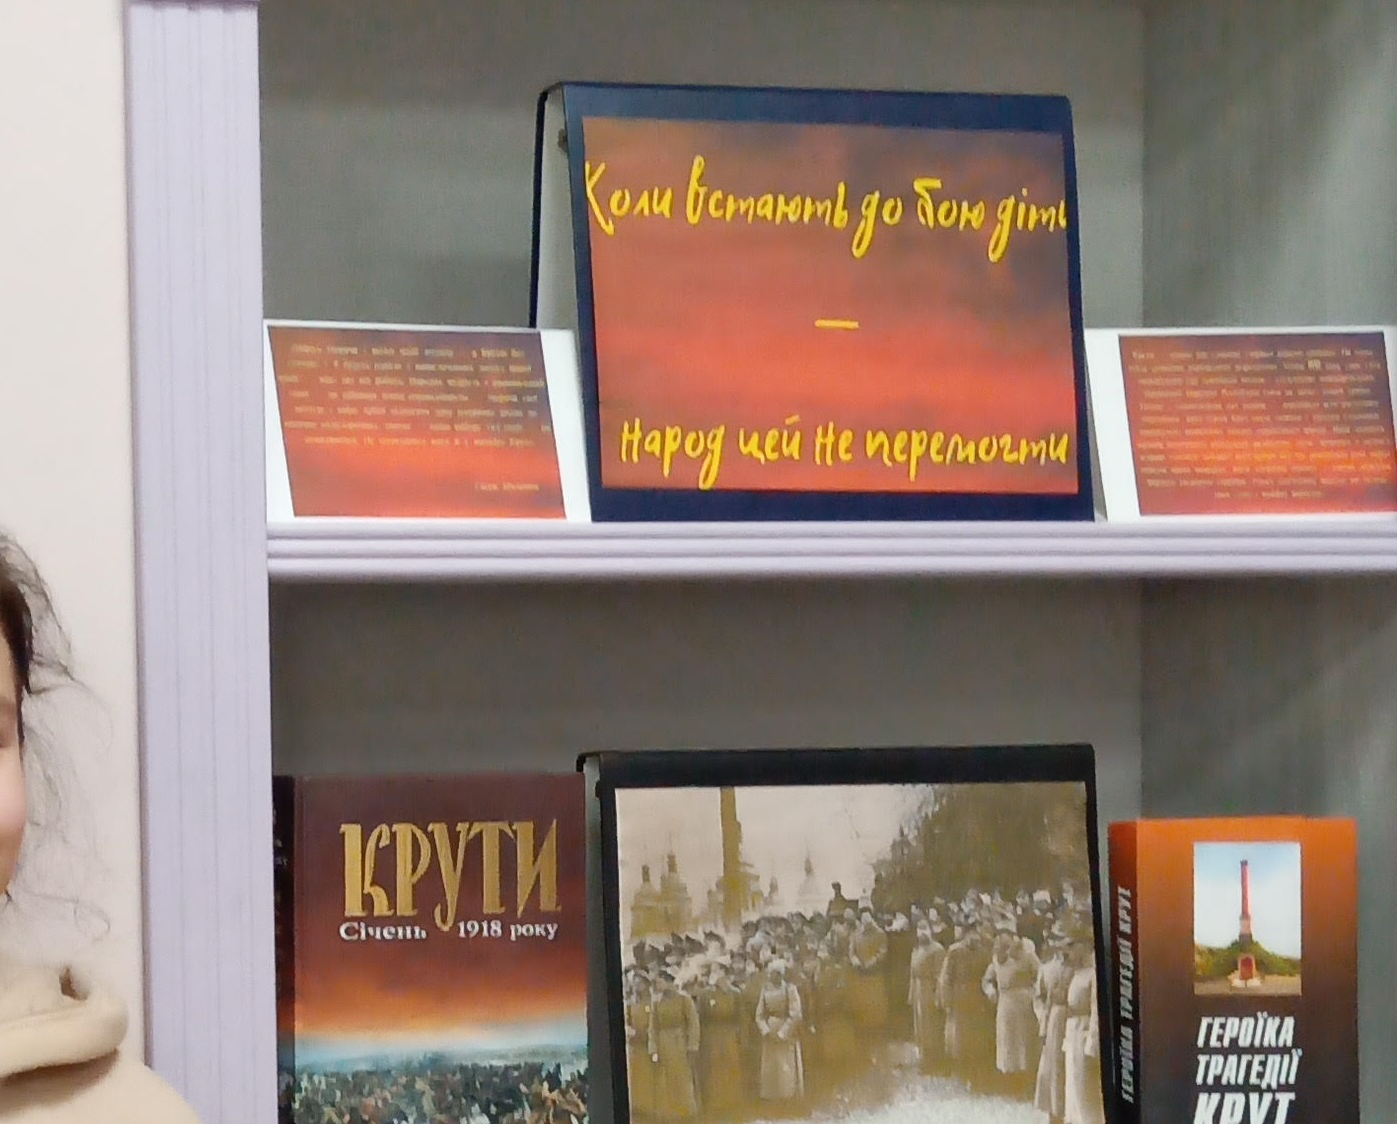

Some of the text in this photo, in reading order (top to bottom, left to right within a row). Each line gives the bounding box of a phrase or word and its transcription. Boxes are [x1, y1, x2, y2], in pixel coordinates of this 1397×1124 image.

[584, 160, 672, 236] Коли
[685, 154, 849, 230] встають
[852, 190, 903, 259] до
[913, 178, 985, 232] бою
[620, 416, 726, 491] Народ
[738, 414, 801, 465] цей
[865, 425, 1069, 483] перемогти
[338, 818, 563, 932] КРУТИ
[339, 919, 559, 942] Січень 1918 року
[1197, 1011, 1295, 1048] ГЕРОЇКА
[1195, 1047, 1303, 1090] ТРАГЕДІЇ
